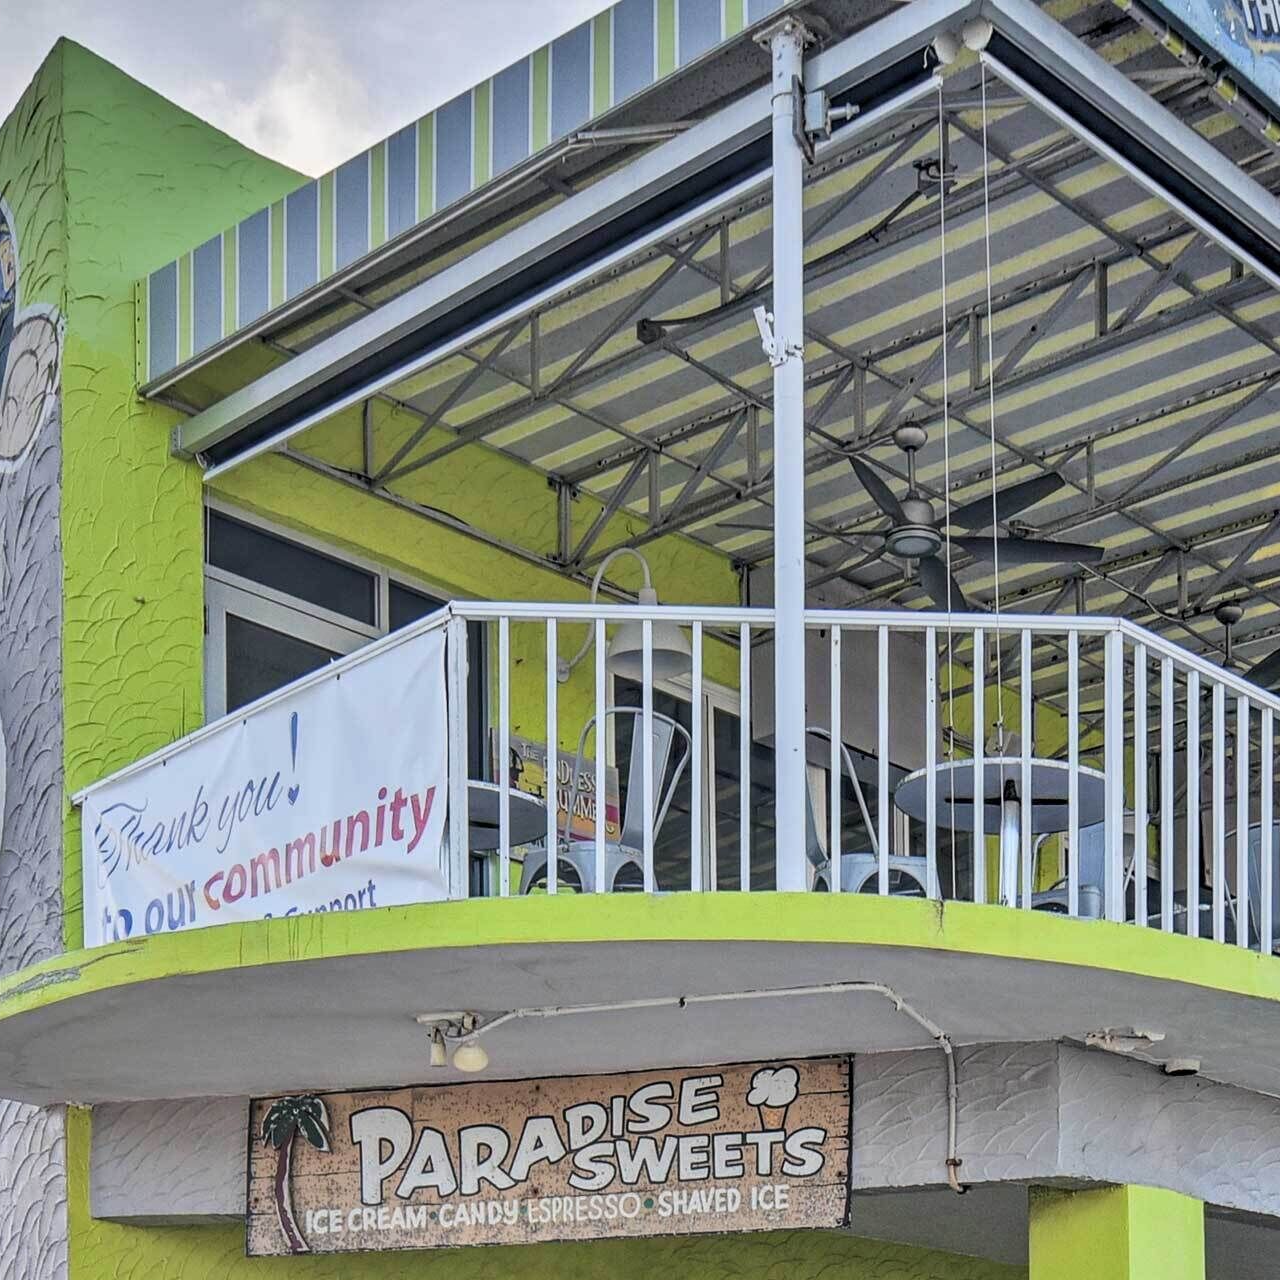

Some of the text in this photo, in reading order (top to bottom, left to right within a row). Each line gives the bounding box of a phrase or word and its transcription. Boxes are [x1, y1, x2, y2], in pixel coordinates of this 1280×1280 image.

[94, 784, 212, 890] Thank
[144, 879, 197, 935] our
[203, 785, 437, 911] community
[349, 1074, 723, 1206] PARADISE
[568, 1126, 828, 1192] SWEETS
[304, 1183, 791, 1234] ICE CREAM CANDY ESPRESSO SHAVED ICE
